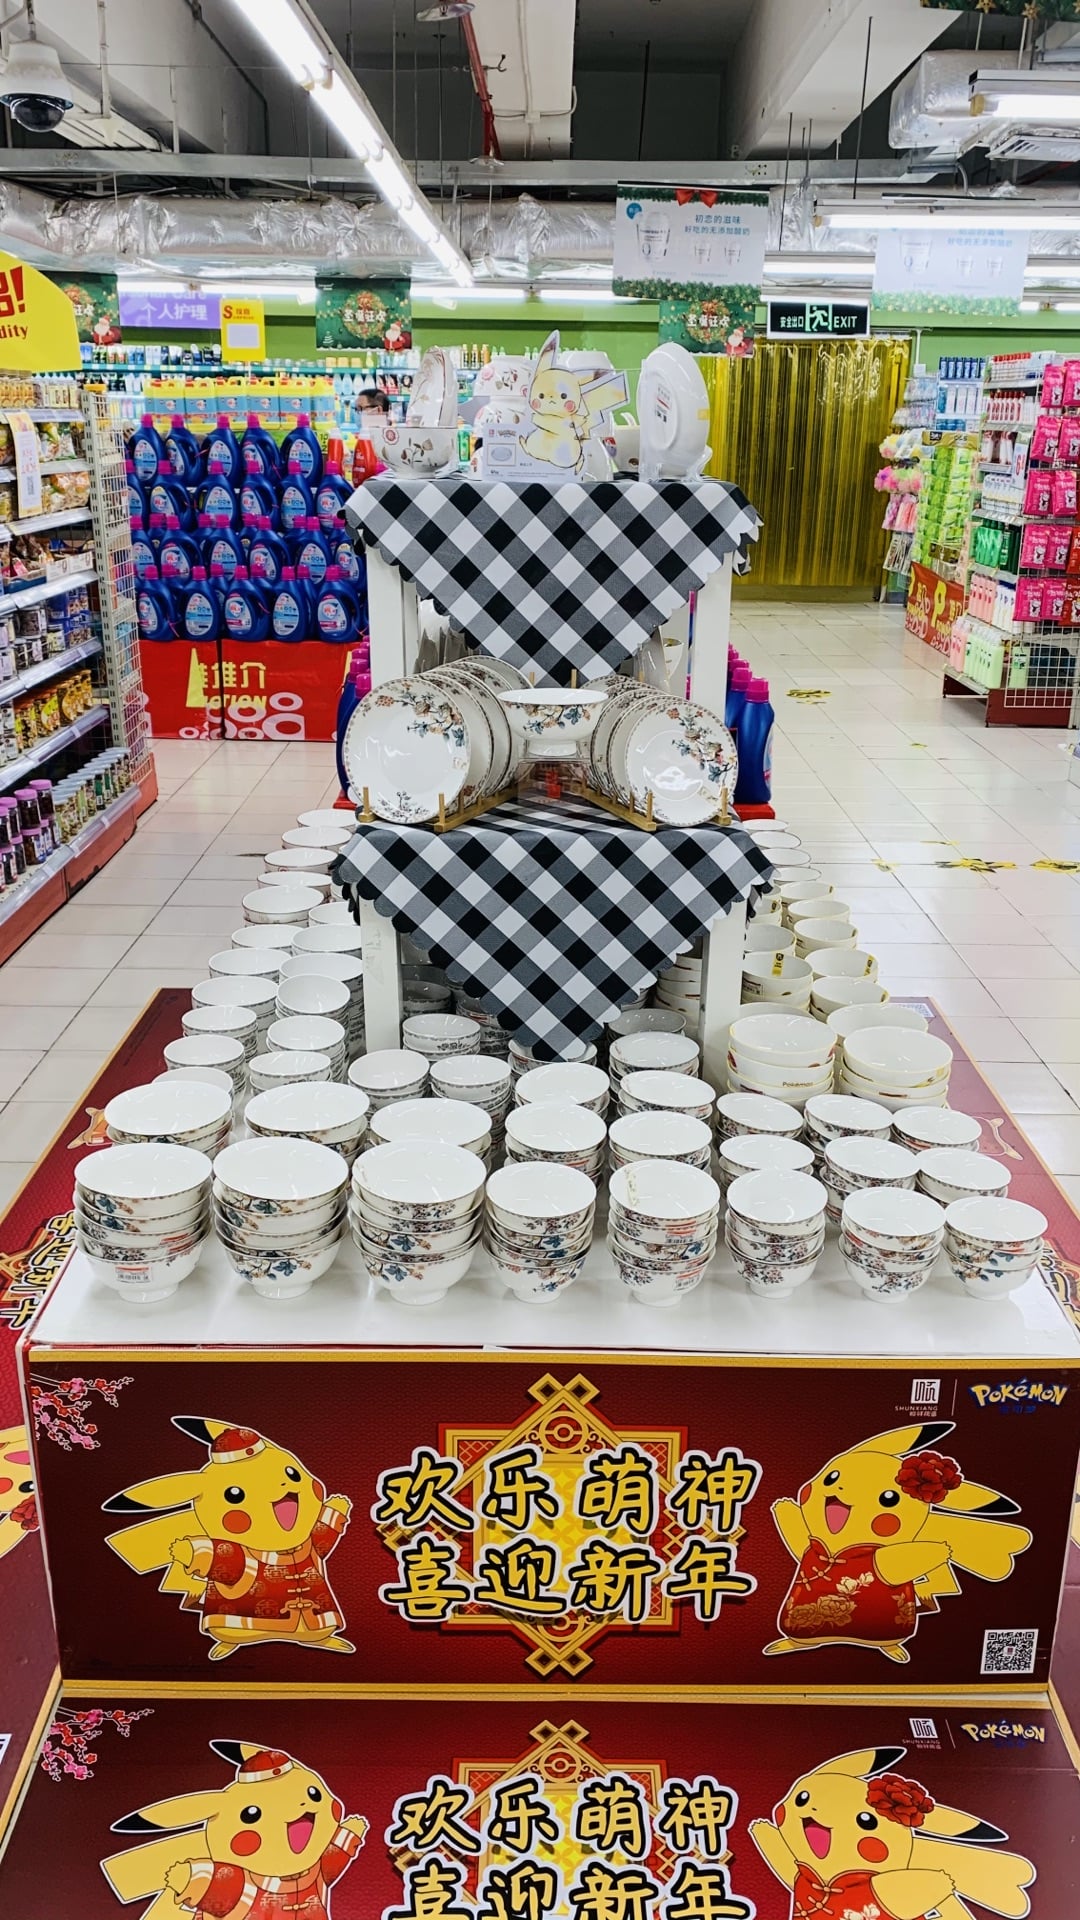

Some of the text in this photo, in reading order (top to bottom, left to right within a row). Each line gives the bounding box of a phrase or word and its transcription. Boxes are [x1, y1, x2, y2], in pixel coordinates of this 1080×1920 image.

[694, 214, 741, 225] 初恋的滋味
[684, 225, 750, 236] 好吃的无添加酸奶
[140, 303, 208, 320] 个人护理
[687, 314, 730, 328] 圣诞狂欢
[780, 316, 804, 328] 安全出口
[833, 316, 858, 328] EXIT
[373, 1444, 761, 1532] 欢乐萌神
[379, 1534, 757, 1622] 喜迎新年
[388, 1777, 737, 1858] 欢乐萌神
